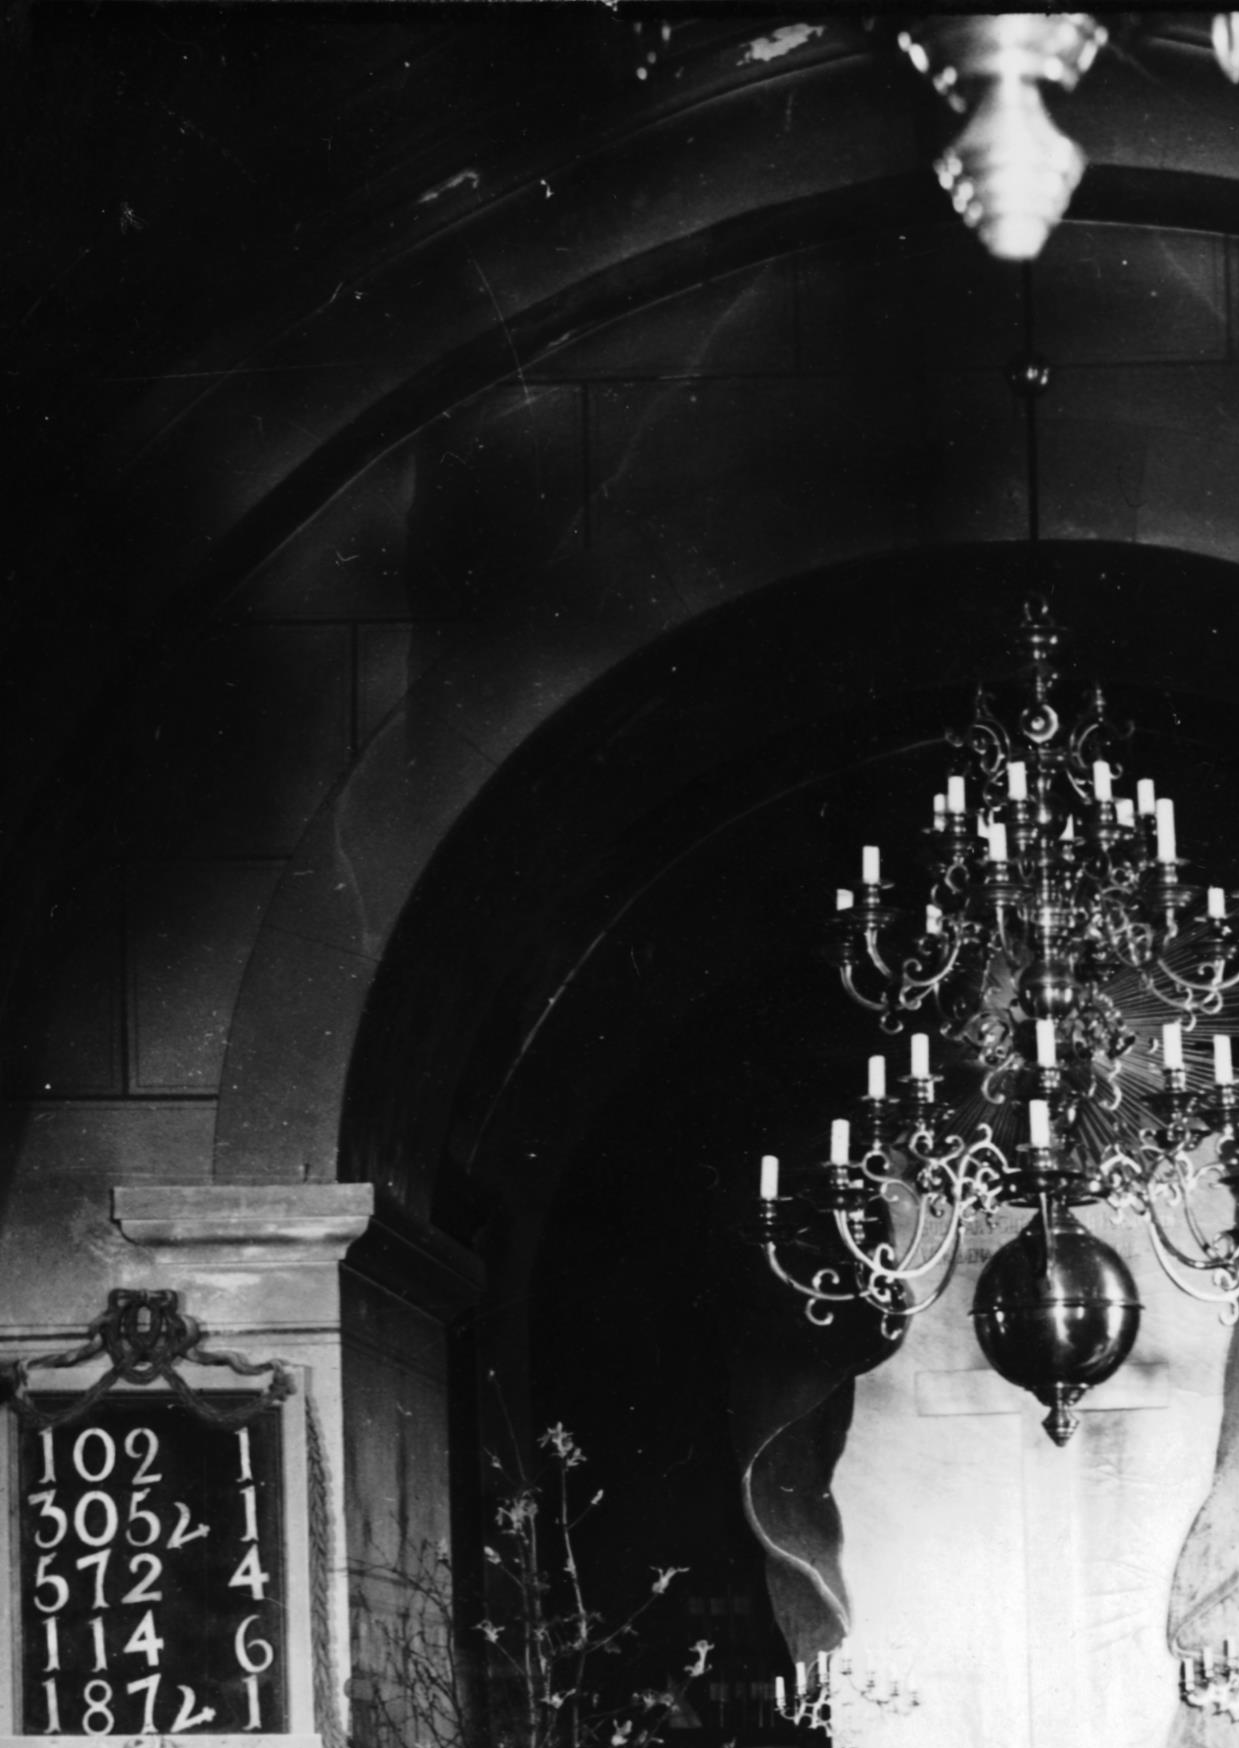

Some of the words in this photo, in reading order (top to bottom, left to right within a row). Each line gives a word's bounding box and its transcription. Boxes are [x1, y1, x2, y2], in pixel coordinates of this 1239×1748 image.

[39, 1427, 162, 1485] 102
[235, 1426, 252, 1482] 1
[240, 1485, 258, 1542] 1
[34, 1549, 162, 1613] 572
[228, 1544, 270, 1600] 4
[42, 1609, 164, 1672] 114
[235, 1615, 273, 1673] 6
[243, 1675, 261, 1730] 1
